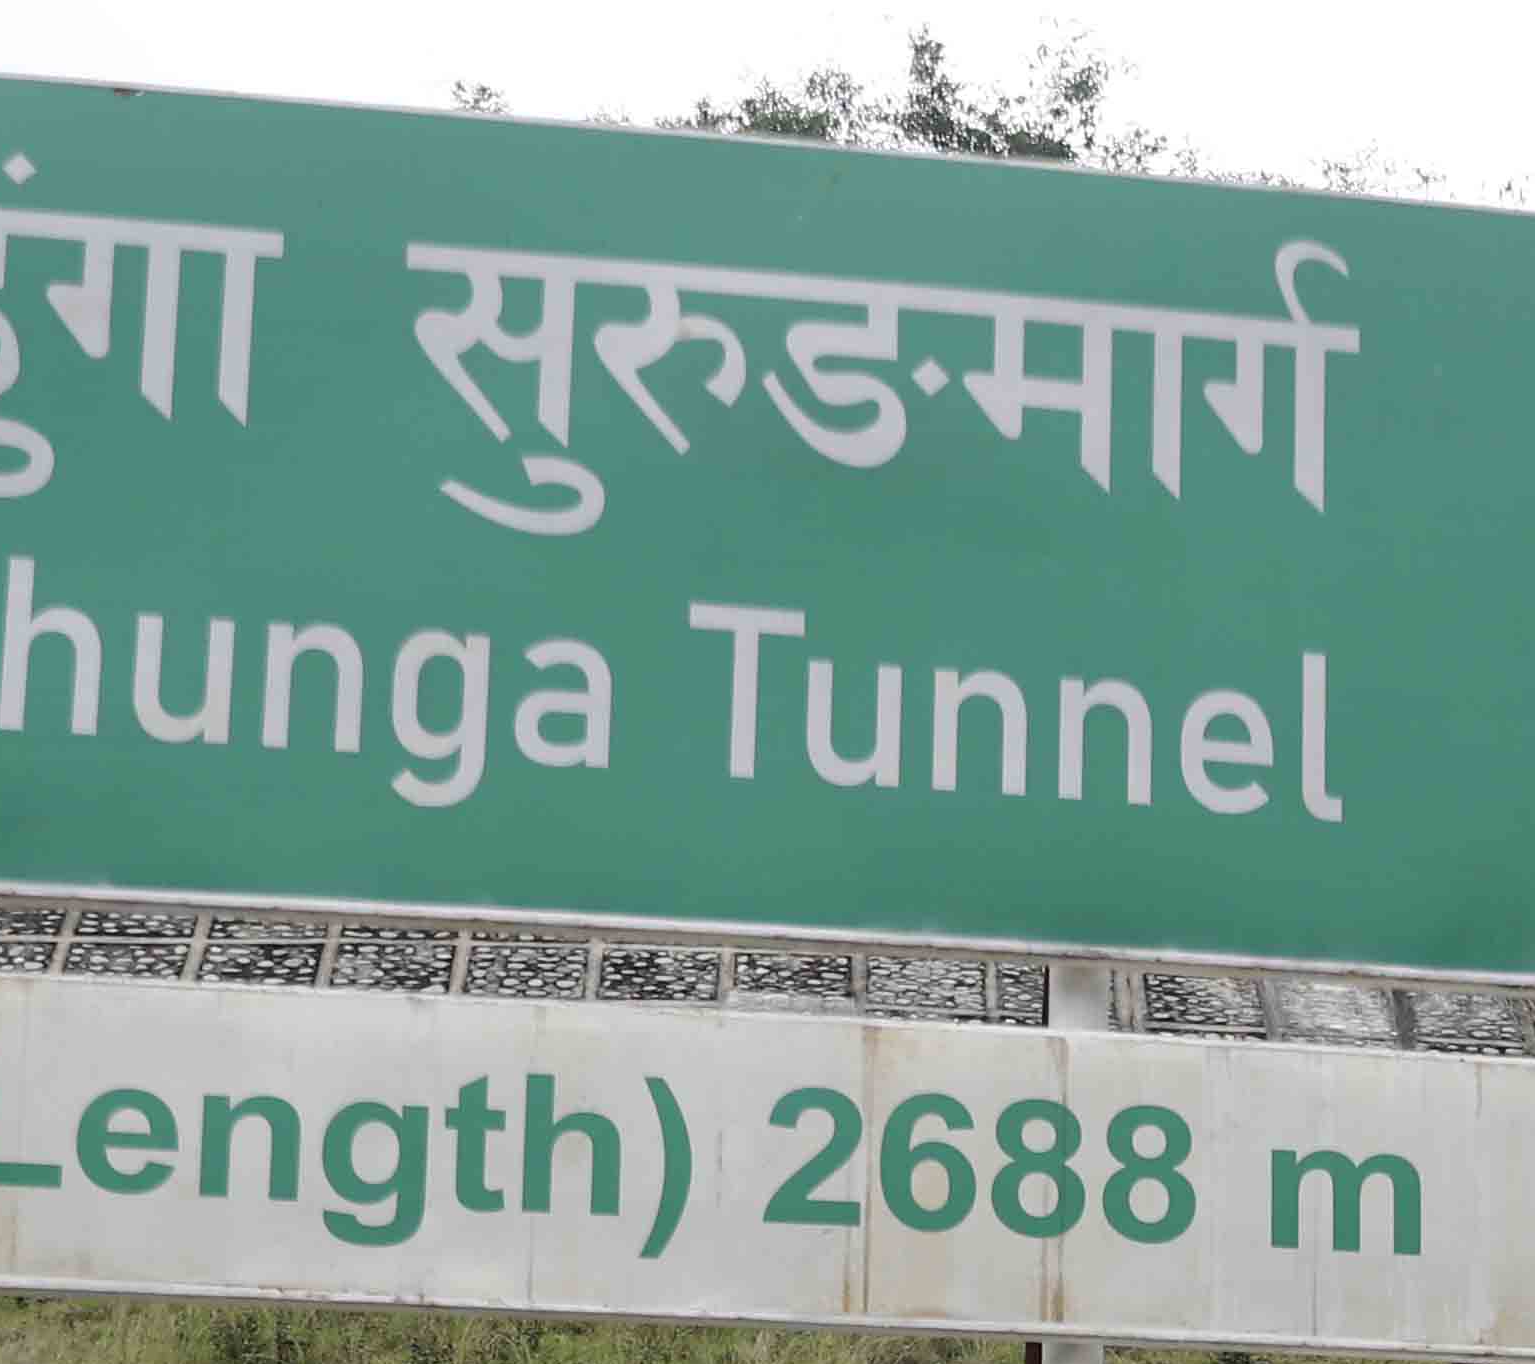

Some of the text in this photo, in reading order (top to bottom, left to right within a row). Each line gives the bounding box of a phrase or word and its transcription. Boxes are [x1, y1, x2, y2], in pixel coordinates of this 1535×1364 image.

[406, 239, 1360, 536] सुरुङमार्ग
[689, 600, 1343, 823] Tunnel
[765, 1087, 1195, 1240] 2688
[1271, 1150, 1422, 1255] m
